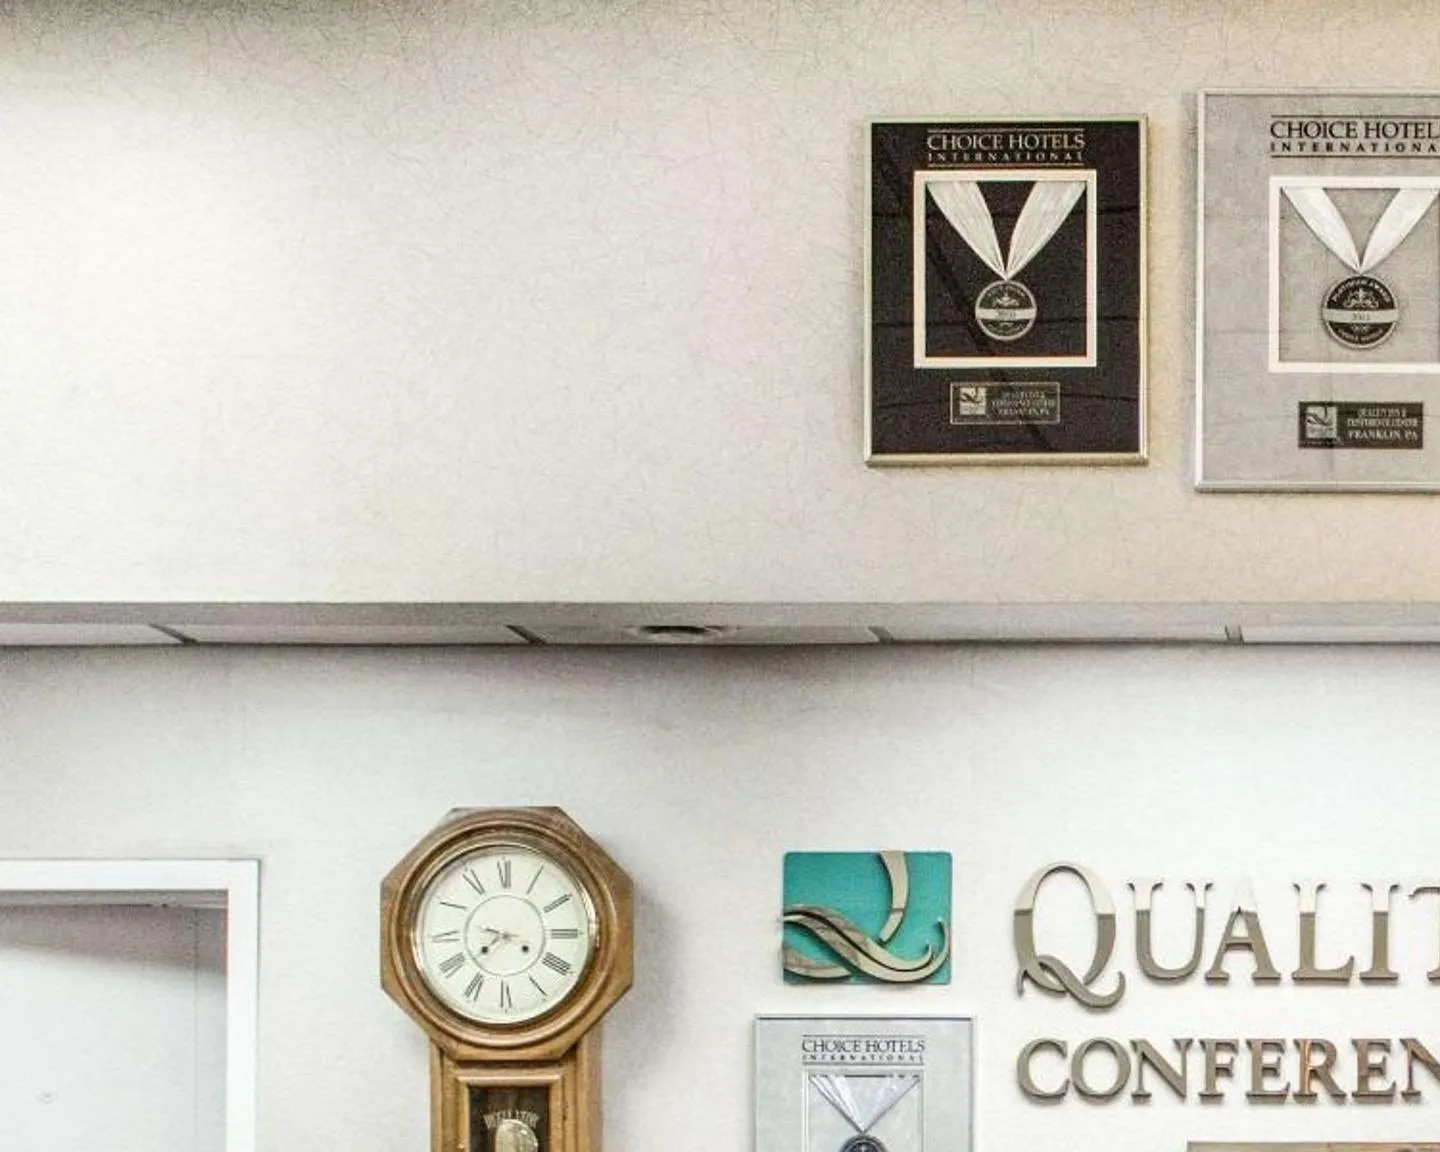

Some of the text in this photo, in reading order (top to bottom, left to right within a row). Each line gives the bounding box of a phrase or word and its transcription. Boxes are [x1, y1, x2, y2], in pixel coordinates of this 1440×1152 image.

[1270, 121, 1358, 139] CHOICE
[926, 133, 1085, 150] CHOICE HOTELS
[928, 152, 1084, 162] INTERNATIONAL
[801, 1039, 926, 1053] CHOICE HOTELS
